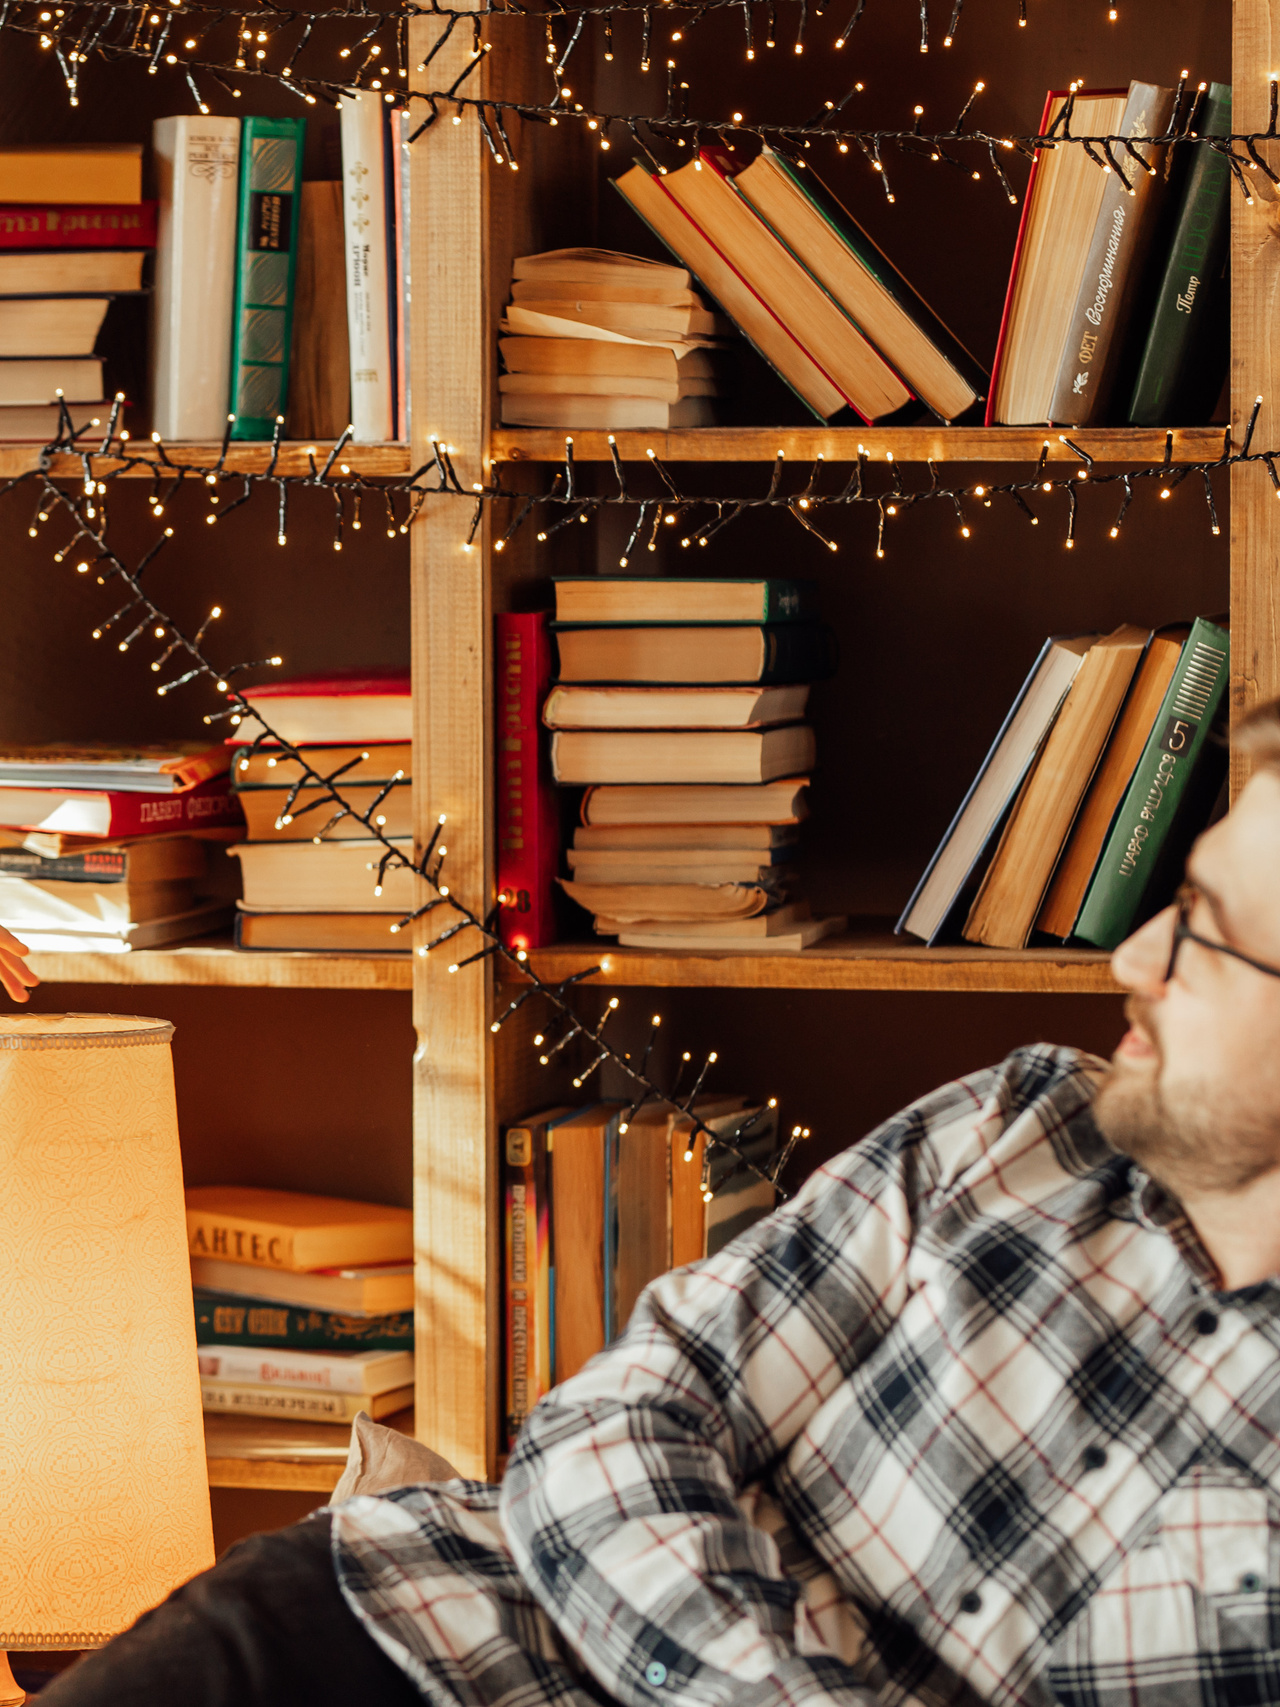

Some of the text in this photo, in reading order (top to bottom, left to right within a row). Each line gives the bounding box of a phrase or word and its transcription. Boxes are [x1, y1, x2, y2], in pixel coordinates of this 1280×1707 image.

[1079, 206, 1126, 364] ФЕТ Воспоминания
[1176, 275, 1201, 314] Петр
[1169, 720, 1189, 751] 5
[1119, 753, 1177, 878] ШАРАФ РАШИДОВ
